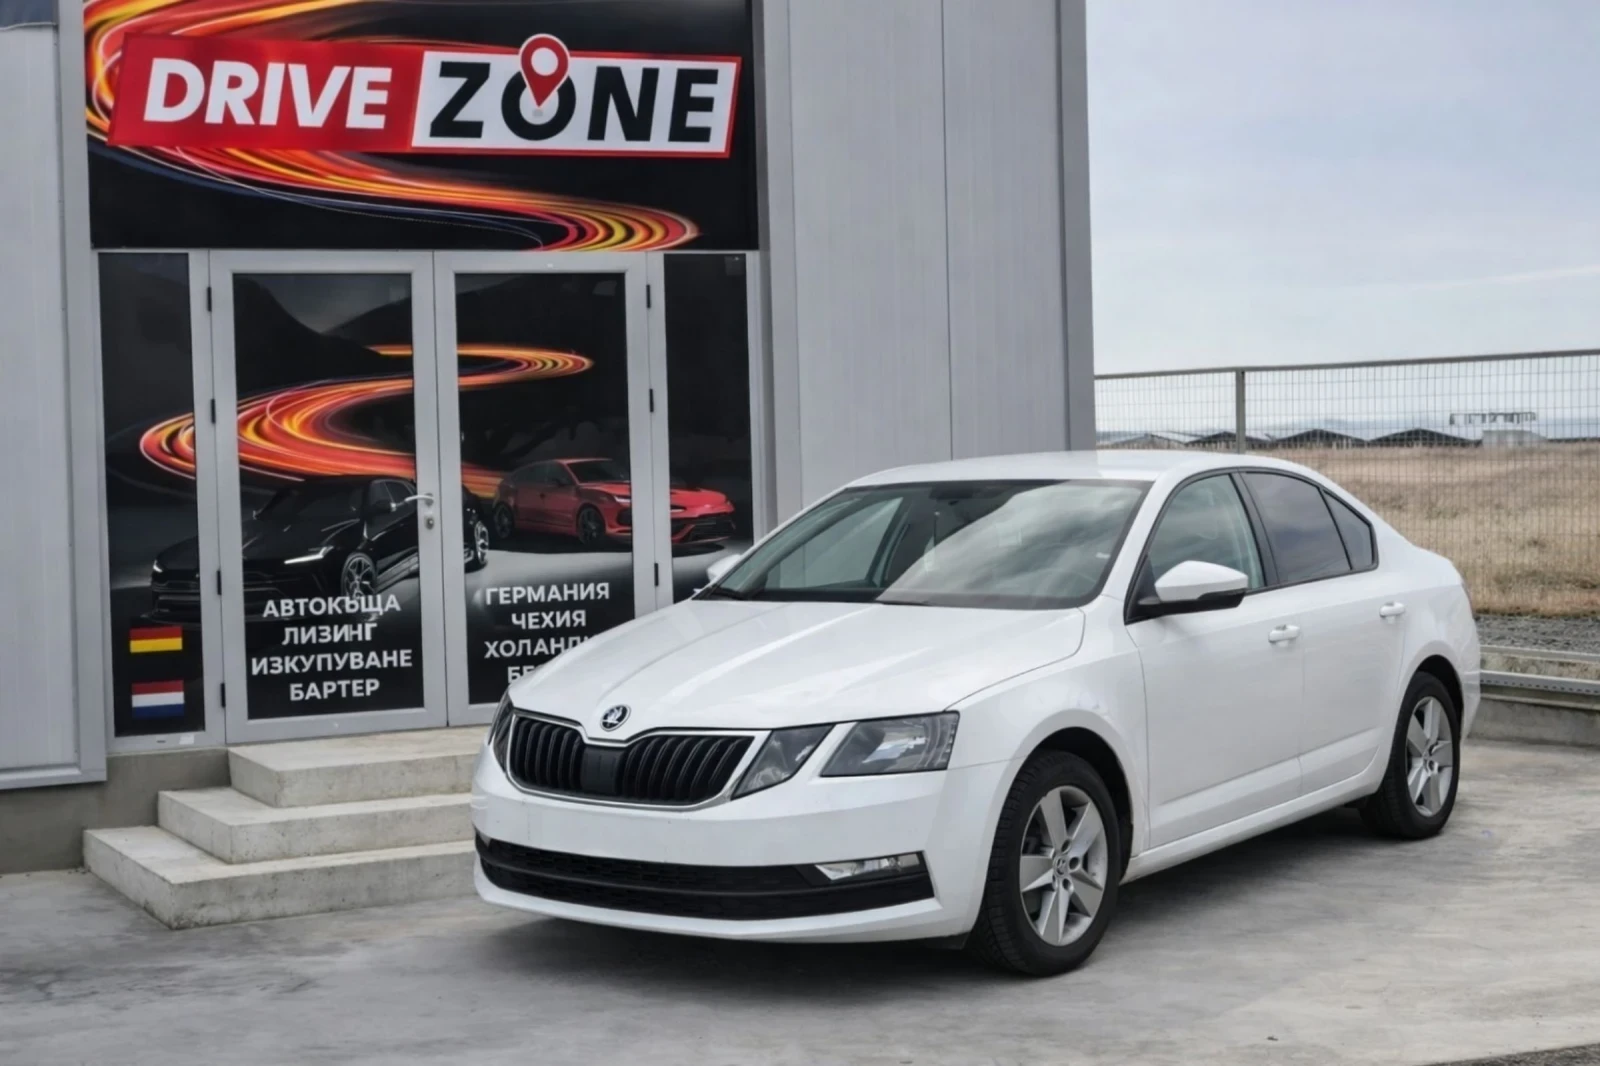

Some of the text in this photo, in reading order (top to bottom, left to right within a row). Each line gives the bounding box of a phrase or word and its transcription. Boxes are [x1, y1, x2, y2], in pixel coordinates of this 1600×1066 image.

[143, 57, 719, 143] DRIVE ZONE
[485, 582, 610, 605] ГЕРМАНИЯ
[262, 594, 401, 618] АВТОКЪЩА
[511, 609, 586, 630] ЧЕХИЯ
[281, 623, 377, 646] ЛИЗИНГ
[484, 635, 589, 659] ХОЛАНД
[251, 649, 413, 676] ИЗКУПУВАНЕ
[289, 678, 380, 702] БАРТЕР
